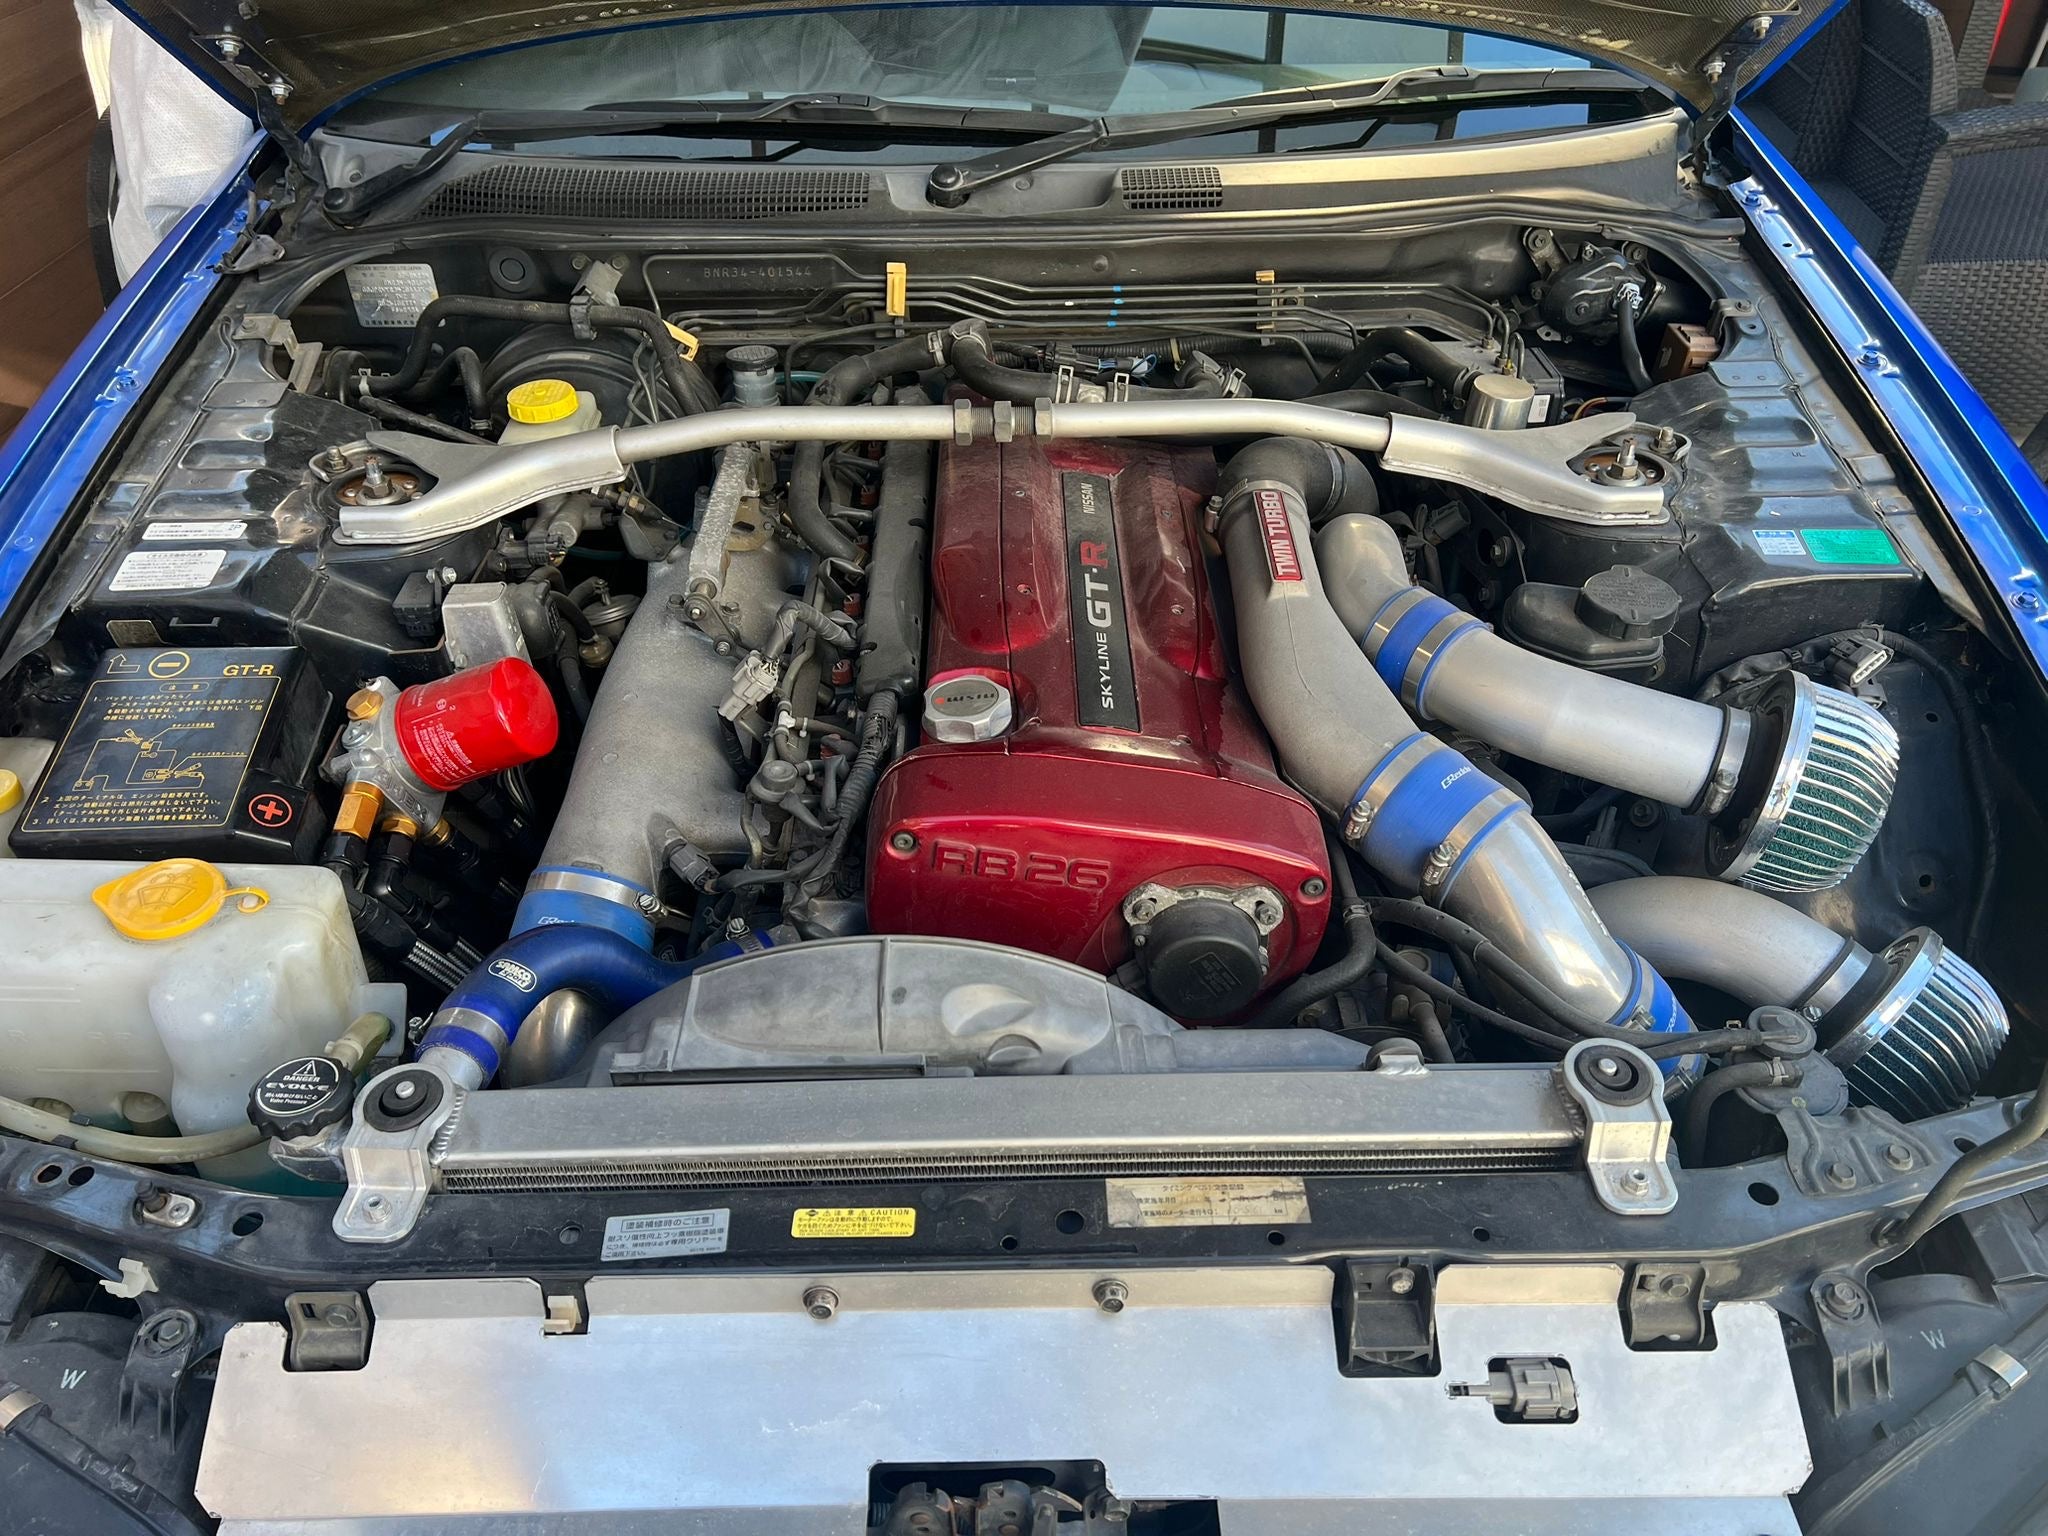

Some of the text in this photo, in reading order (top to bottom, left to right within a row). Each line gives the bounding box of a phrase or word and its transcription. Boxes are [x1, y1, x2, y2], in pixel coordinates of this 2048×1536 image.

[704, 267, 812, 278] BNR34-401544
[1082, 482, 1096, 514] NISSAN
[1260, 491, 1297, 576] TWIN TURBO
[223, 664, 275, 677] GT-R
[1096, 631, 1114, 709] SKYLINE
[495, 961, 532, 981] SAMCO
[499, 969, 527, 988] sport
[266, 1082, 330, 1091] EVOLVE
[283, 1075, 321, 1083] DANGER
[1920, 1329, 1947, 1350] W
[60, 1368, 88, 1390] W
